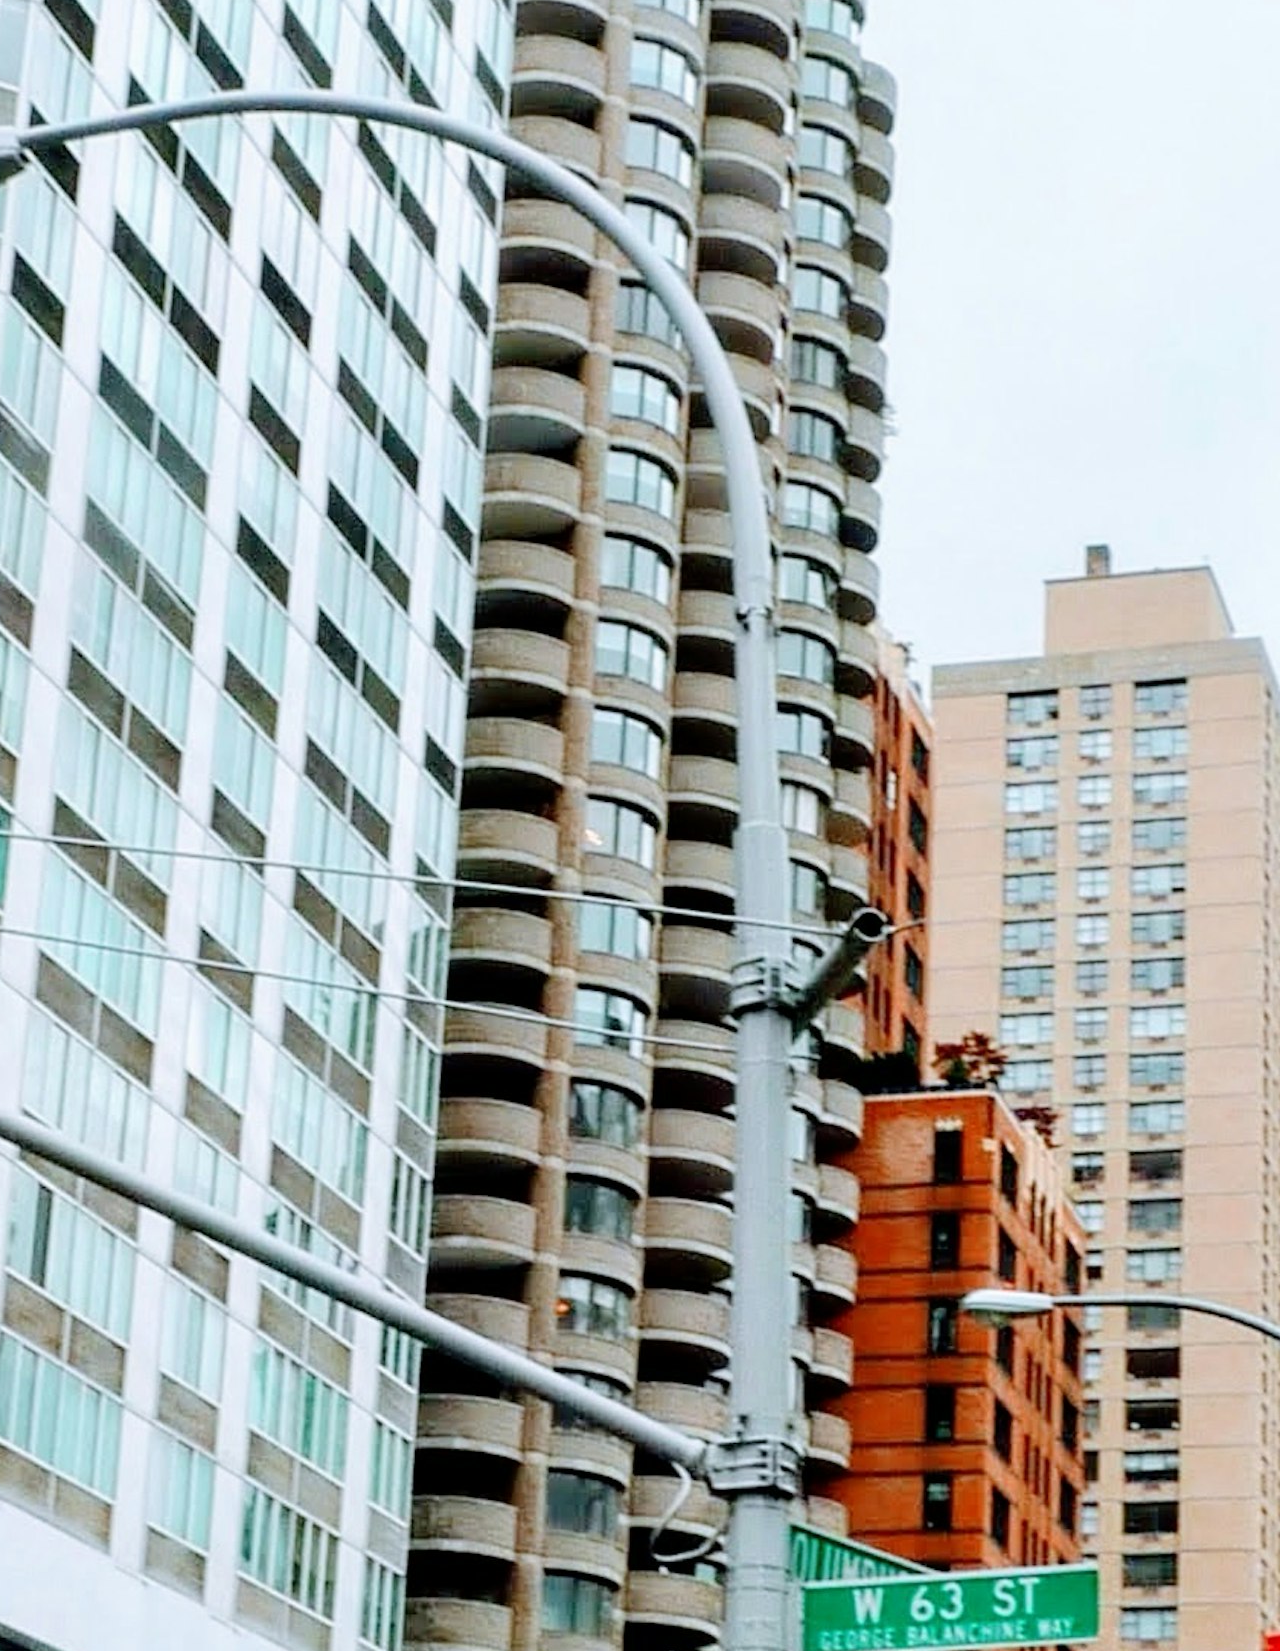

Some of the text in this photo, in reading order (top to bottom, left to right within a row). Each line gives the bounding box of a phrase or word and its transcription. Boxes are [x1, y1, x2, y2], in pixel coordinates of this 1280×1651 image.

[853, 1577, 1040, 1625] W 63 ST
[821, 1616, 1074, 1651] GEORGE BALANCHINE WAY
